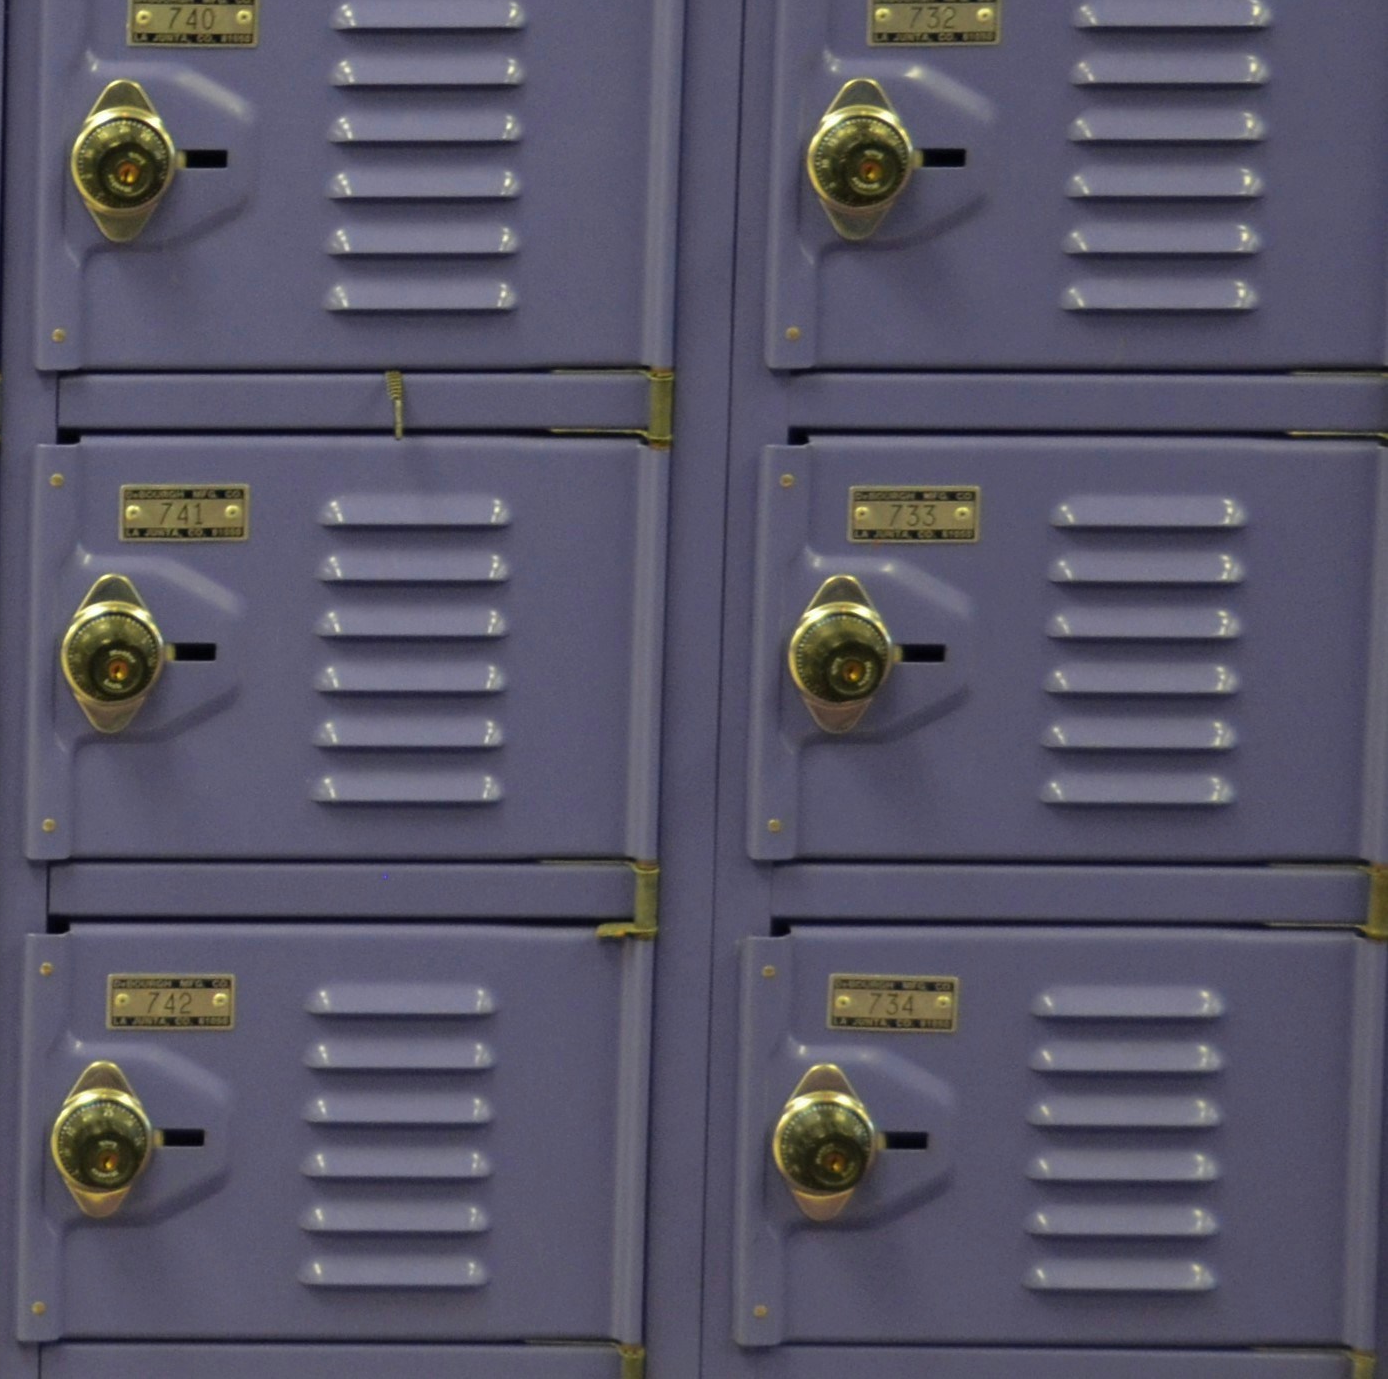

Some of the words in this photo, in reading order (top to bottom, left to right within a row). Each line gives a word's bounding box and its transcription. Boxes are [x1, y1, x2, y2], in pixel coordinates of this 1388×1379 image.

[168, 7, 215, 31] 740
[909, 5, 957, 30] 732
[159, 502, 205, 525] 741
[888, 503, 936, 527] 733
[146, 991, 192, 1014] 742
[867, 992, 915, 1016] 734
